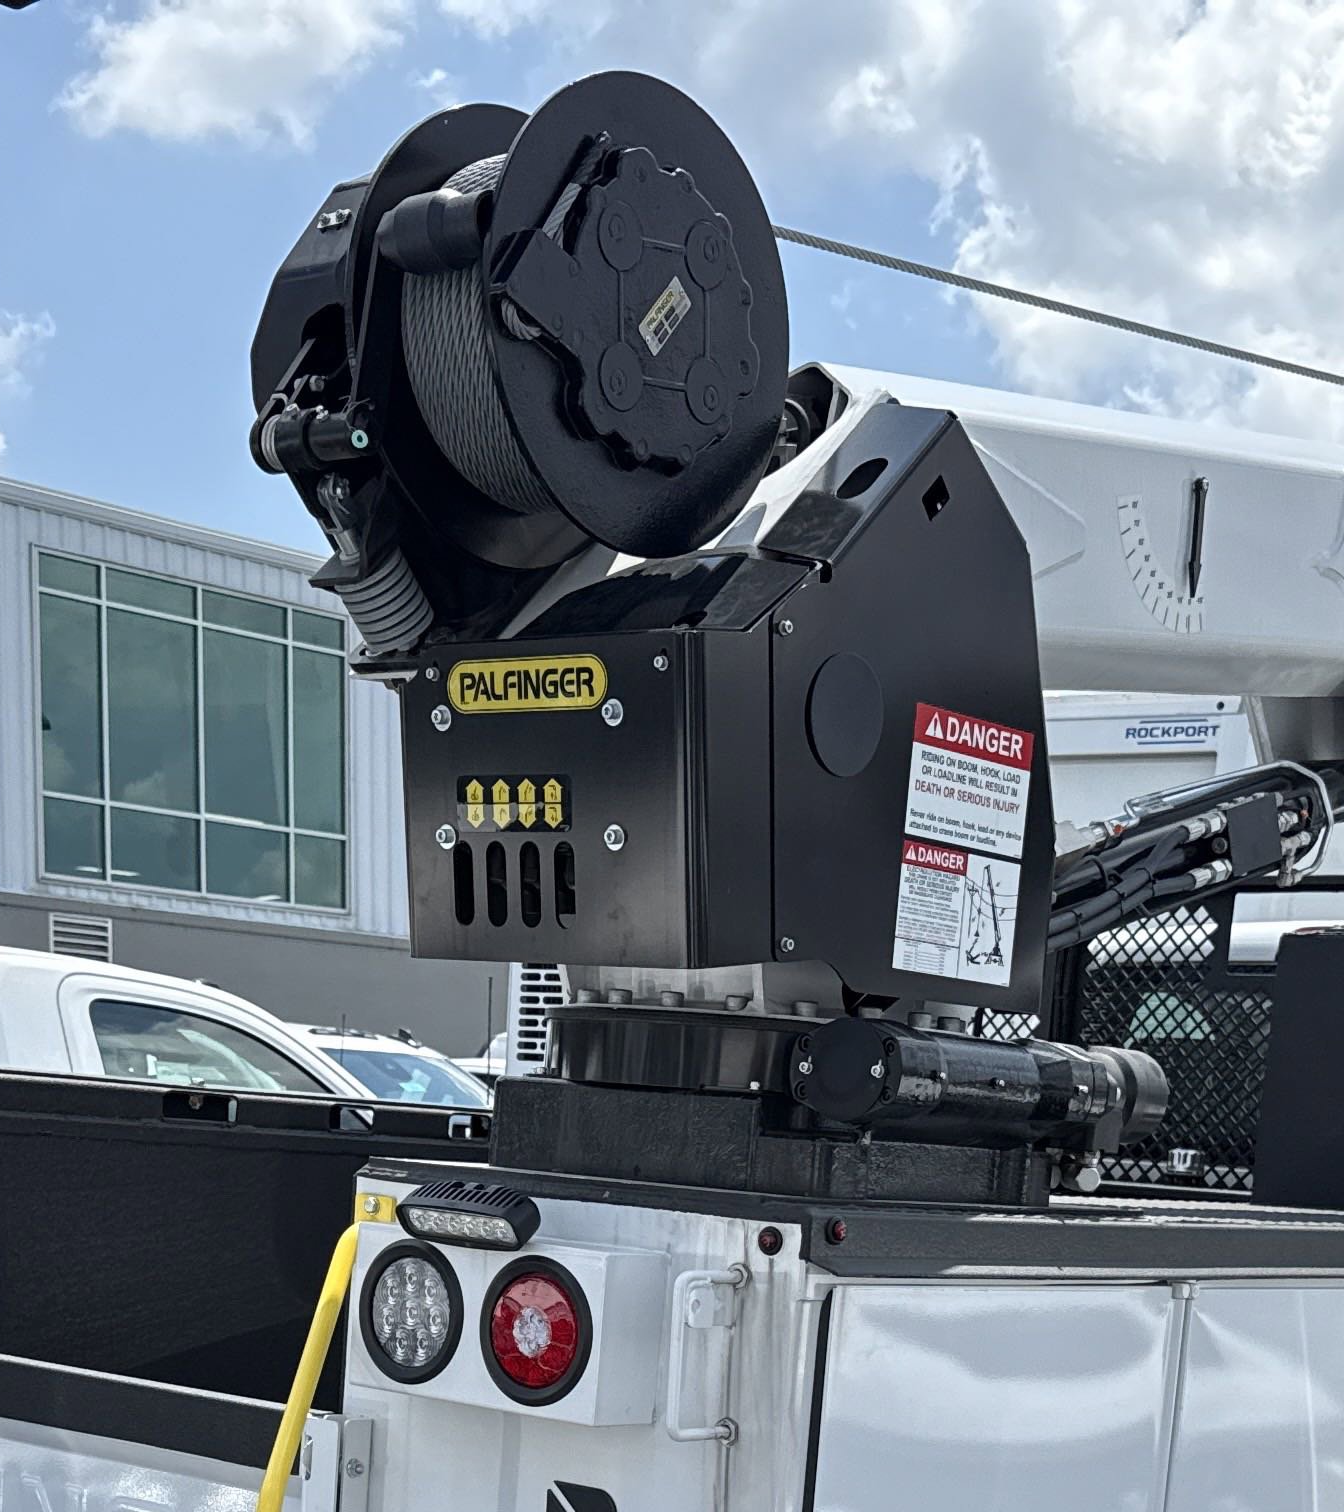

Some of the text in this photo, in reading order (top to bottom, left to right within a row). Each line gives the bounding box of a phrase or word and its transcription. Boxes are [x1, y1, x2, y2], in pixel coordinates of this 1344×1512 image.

[459, 666, 595, 702] PALFINGER
[946, 716, 1023, 760] DANGER
[1125, 725, 1221, 739] ROCKPORT
[921, 750, 944, 765] RIDING
[946, 756, 956, 768] ON
[1003, 772, 1021, 784] LOAD
[922, 765, 932, 776] OR
[968, 776, 983, 789] WILL
[985, 781, 1010, 795] RESULT
[915, 779, 1019, 814] DEATH OR SERIOUS INJURY
[918, 846, 964, 870] DANGER
